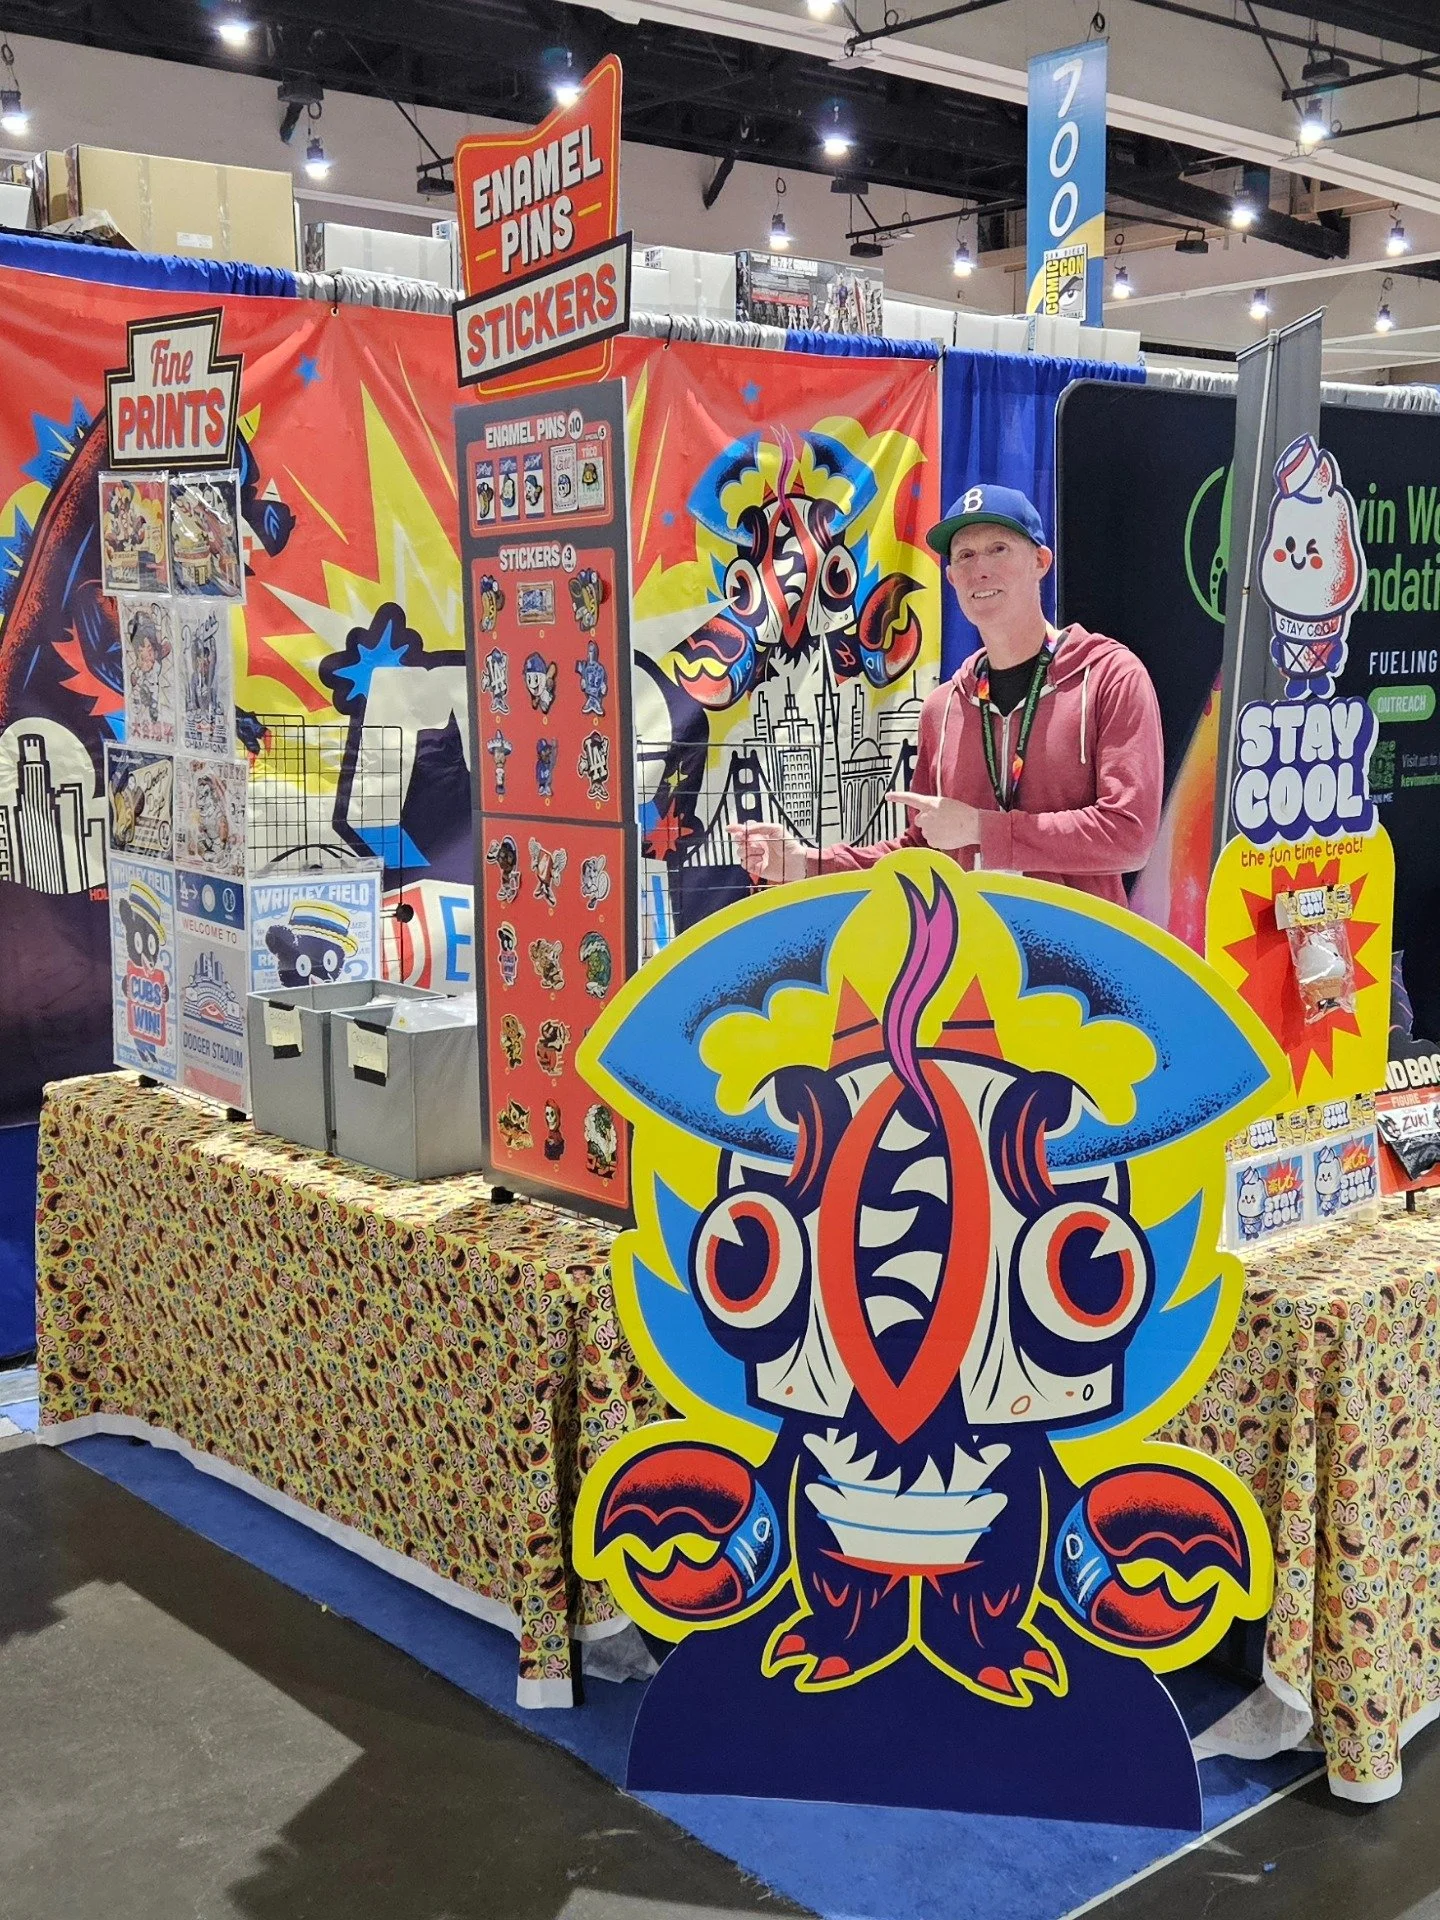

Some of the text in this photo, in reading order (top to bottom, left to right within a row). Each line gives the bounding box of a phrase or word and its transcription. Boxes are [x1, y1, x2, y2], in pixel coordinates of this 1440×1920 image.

[1049, 58, 1084, 238] 700
[473, 124, 604, 230] ENAMEL
[501, 195, 574, 275] PINS
[1059, 254, 1084, 277] CON
[1046, 260, 1059, 315] COMIC
[467, 263, 618, 368] STICKERS
[150, 339, 193, 387] Fine
[118, 387, 226, 451] PRINTS
[485, 421, 536, 450] ENAMEL
[536, 414, 566, 441] PINS
[963, 487, 983, 514] B
[499, 545, 561, 571] STICKERS
[1279, 618, 1337, 638] STAY COOL
[1369, 650, 1438, 676] FUELING
[1377, 694, 1427, 713] OUTREACH
[1240, 700, 1365, 767] STAY
[185, 740, 228, 754] CHAMPIONS
[1234, 762, 1364, 829] COOL
[1241, 837, 1364, 867] the fun time treat!
[113, 866, 171, 898] WRIGLEY FIELD
[254, 882, 370, 915] WRIGLEY FIELD
[1299, 890, 1323, 905] STAY
[1300, 902, 1325, 917] COOL
[183, 918, 223, 940] WELCOME
[226, 931, 237, 944] TO
[131, 974, 162, 1006] CUBS
[133, 1005, 161, 1038] WIN!
[183, 1031, 244, 1069] DODGER STADIUM
[1323, 1101, 1347, 1117] STAY
[1391, 1092, 1421, 1108] FIGURE
[1250, 1119, 1275, 1137] STAY
[1323, 1113, 1350, 1129] COOL
[1250, 1131, 1277, 1149] COOL
[1340, 1166, 1371, 1188] STAY
[1264, 1190, 1298, 1212] STAY
[1341, 1182, 1373, 1206] COOL
[1263, 1206, 1300, 1228] COOL
